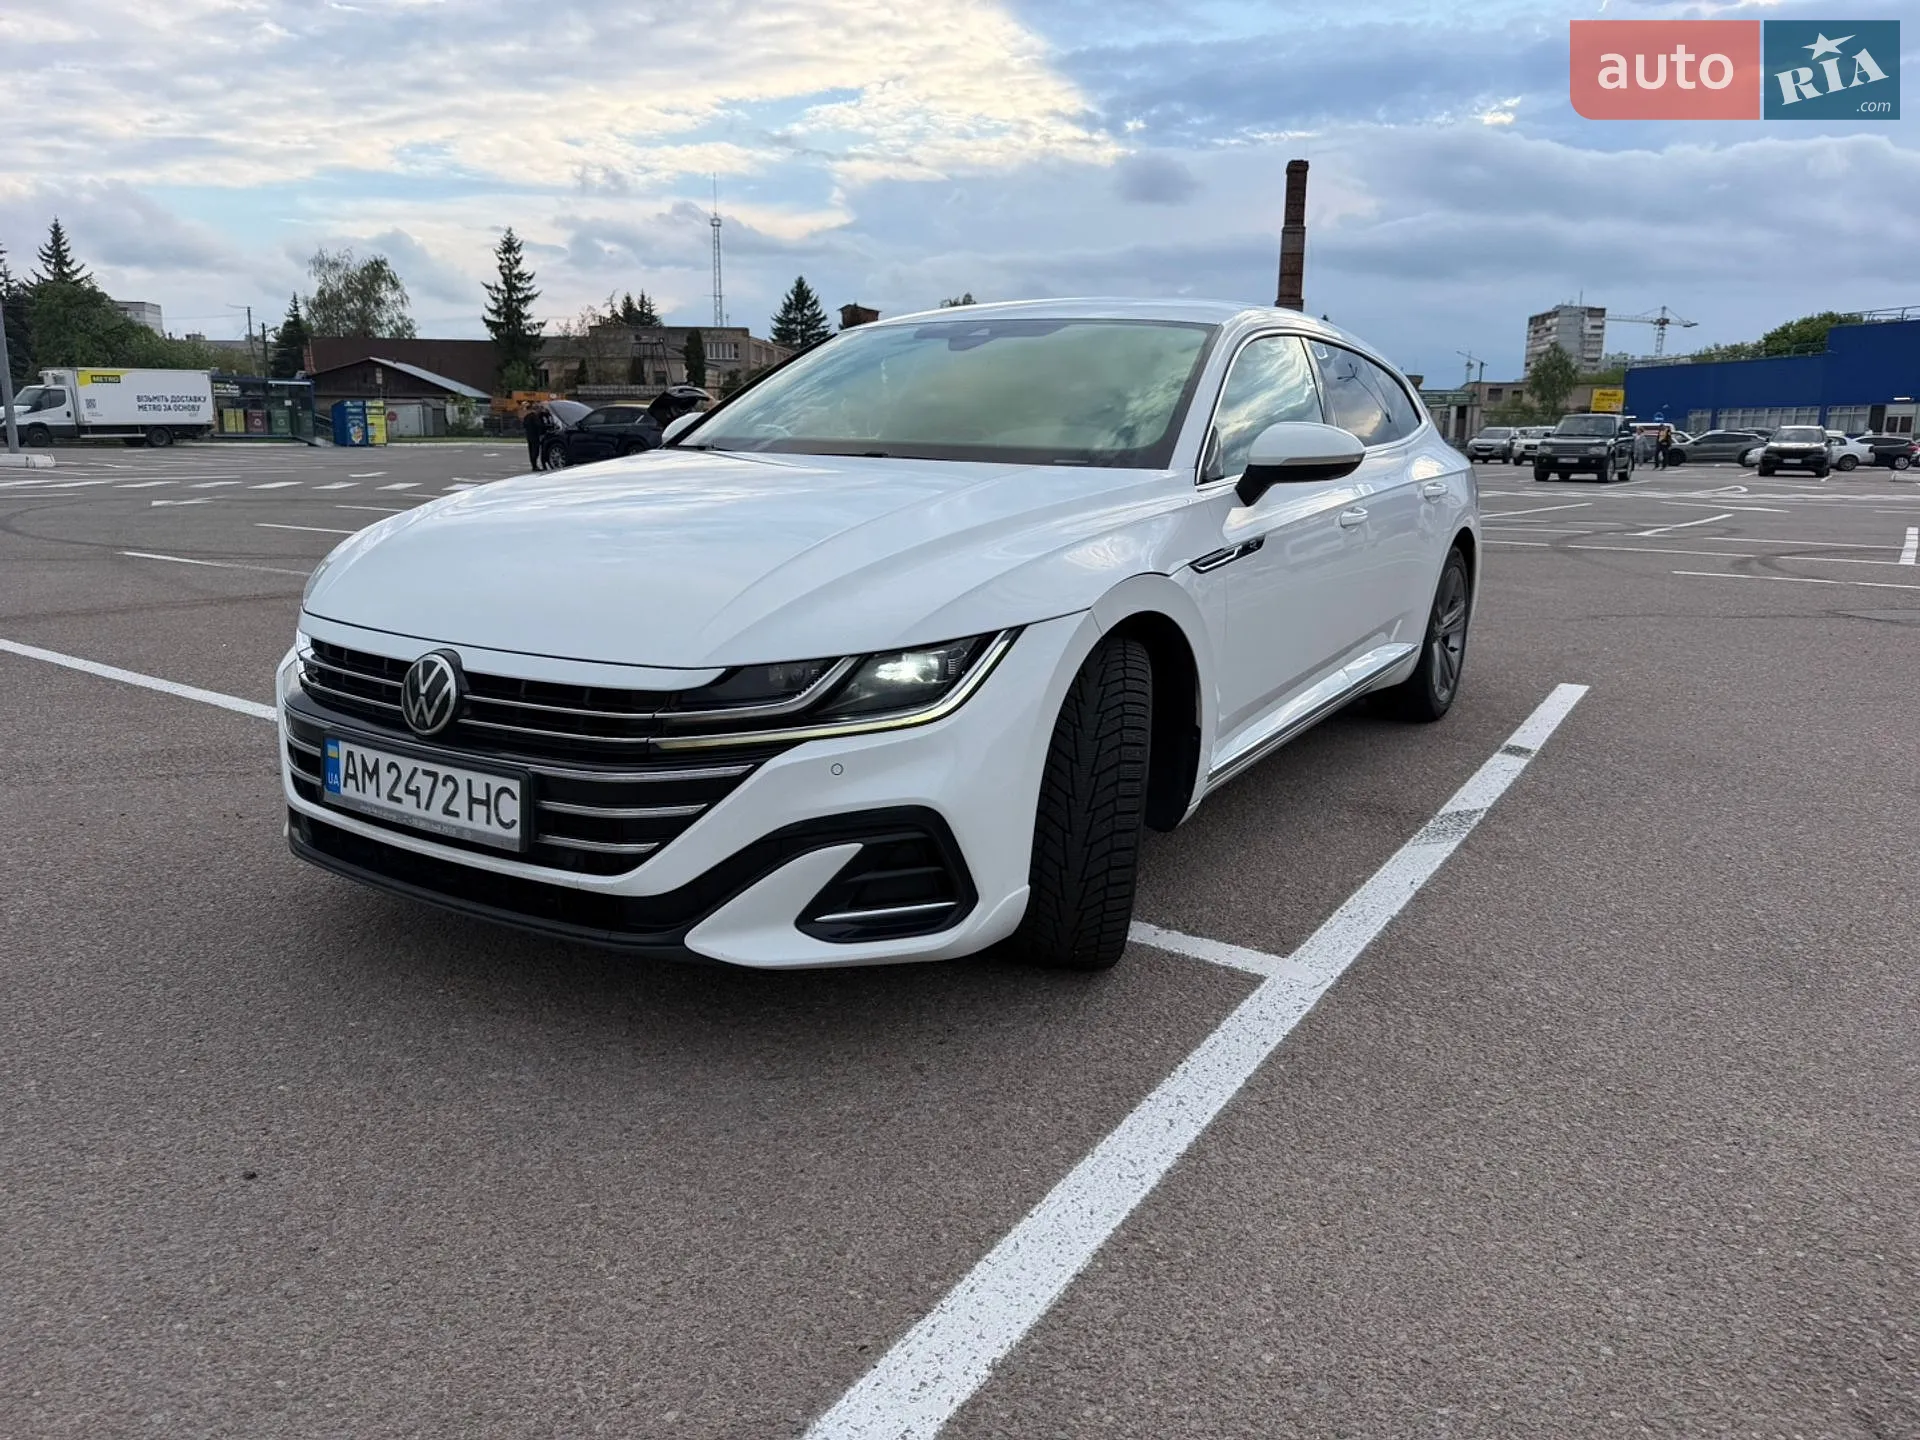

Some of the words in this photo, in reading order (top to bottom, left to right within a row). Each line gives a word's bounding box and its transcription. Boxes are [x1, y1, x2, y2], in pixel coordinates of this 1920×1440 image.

[136, 394, 169, 403] ВІЗЬМІТЬ
[170, 395, 207, 404] ДОСТАВКУ
[137, 404, 162, 412] METRO
[163, 404, 172, 412] ЗА
[173, 404, 200, 412] ОСНОВУ
[327, 772, 340, 786] UA
